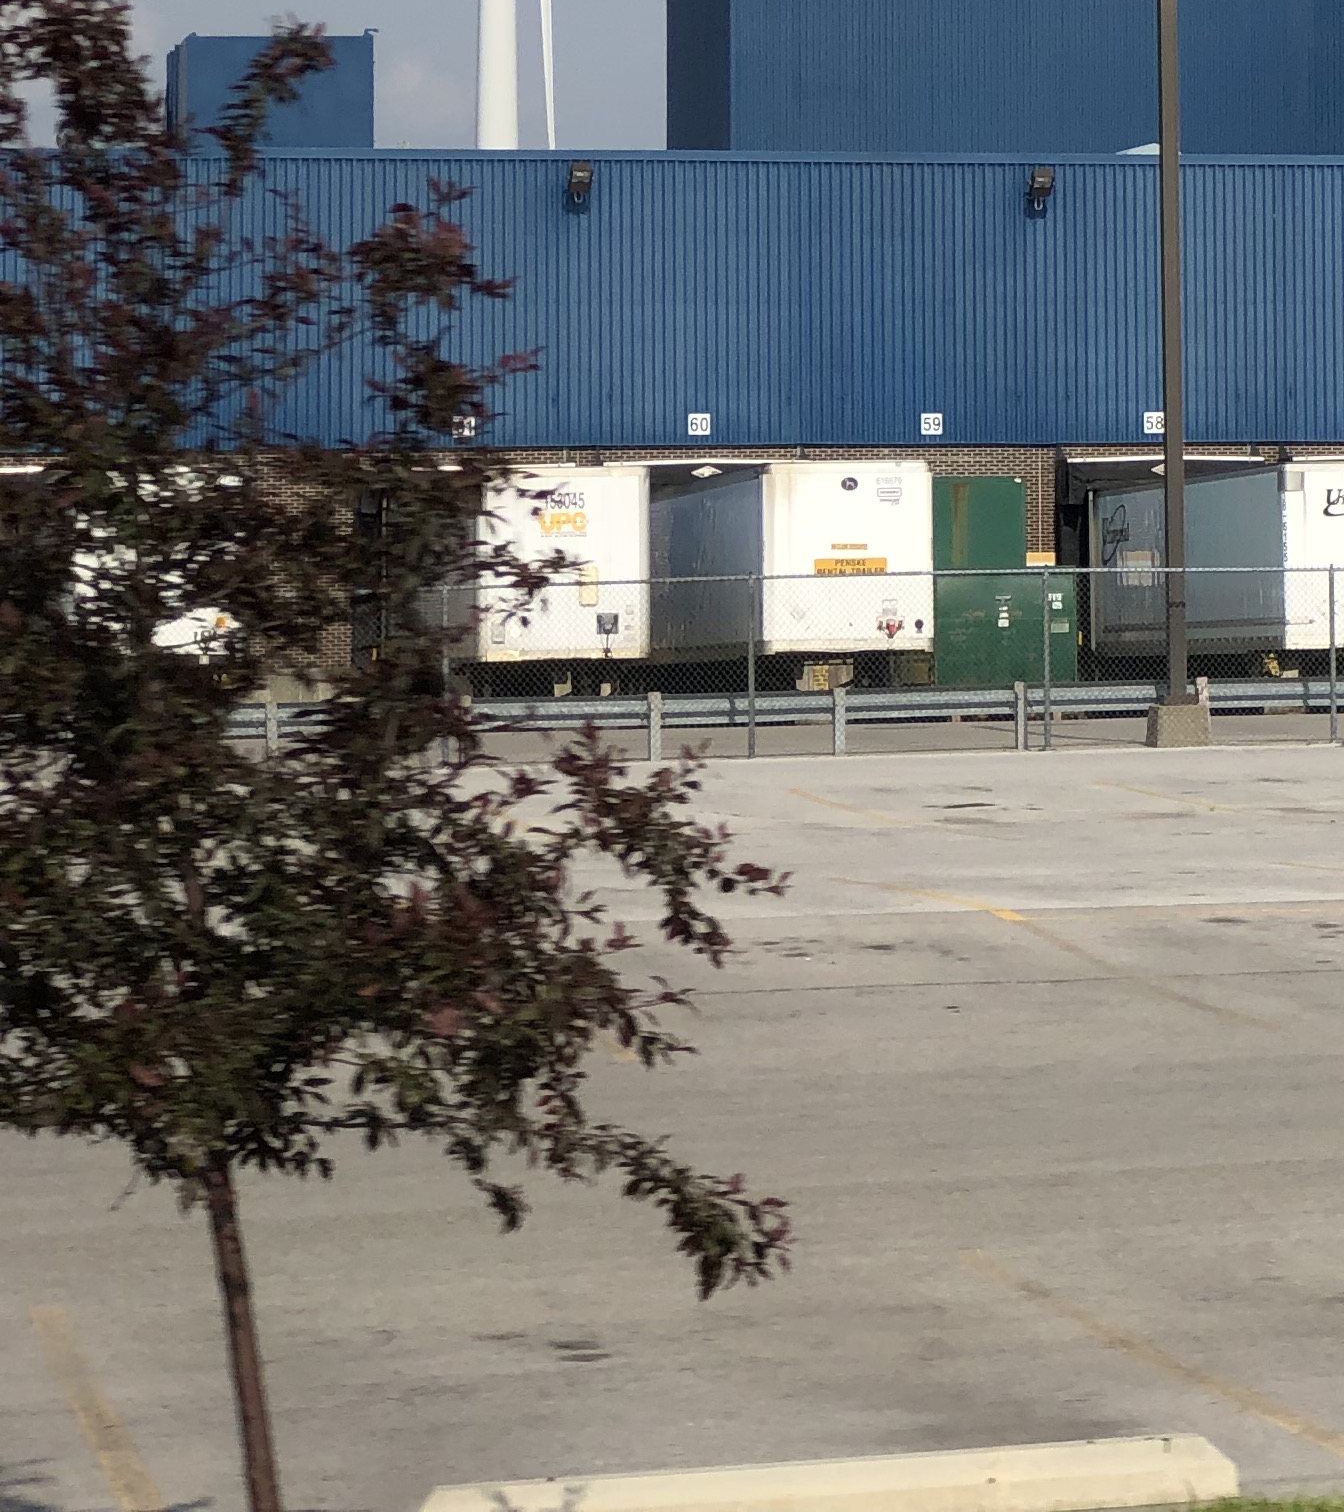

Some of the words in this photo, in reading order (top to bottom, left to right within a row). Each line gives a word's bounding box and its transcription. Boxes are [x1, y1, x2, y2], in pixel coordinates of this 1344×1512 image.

[690, 417, 709, 432] 60
[923, 417, 941, 432] 59
[1145, 416, 1164, 430] 58
[834, 558, 867, 567] PENSKE
